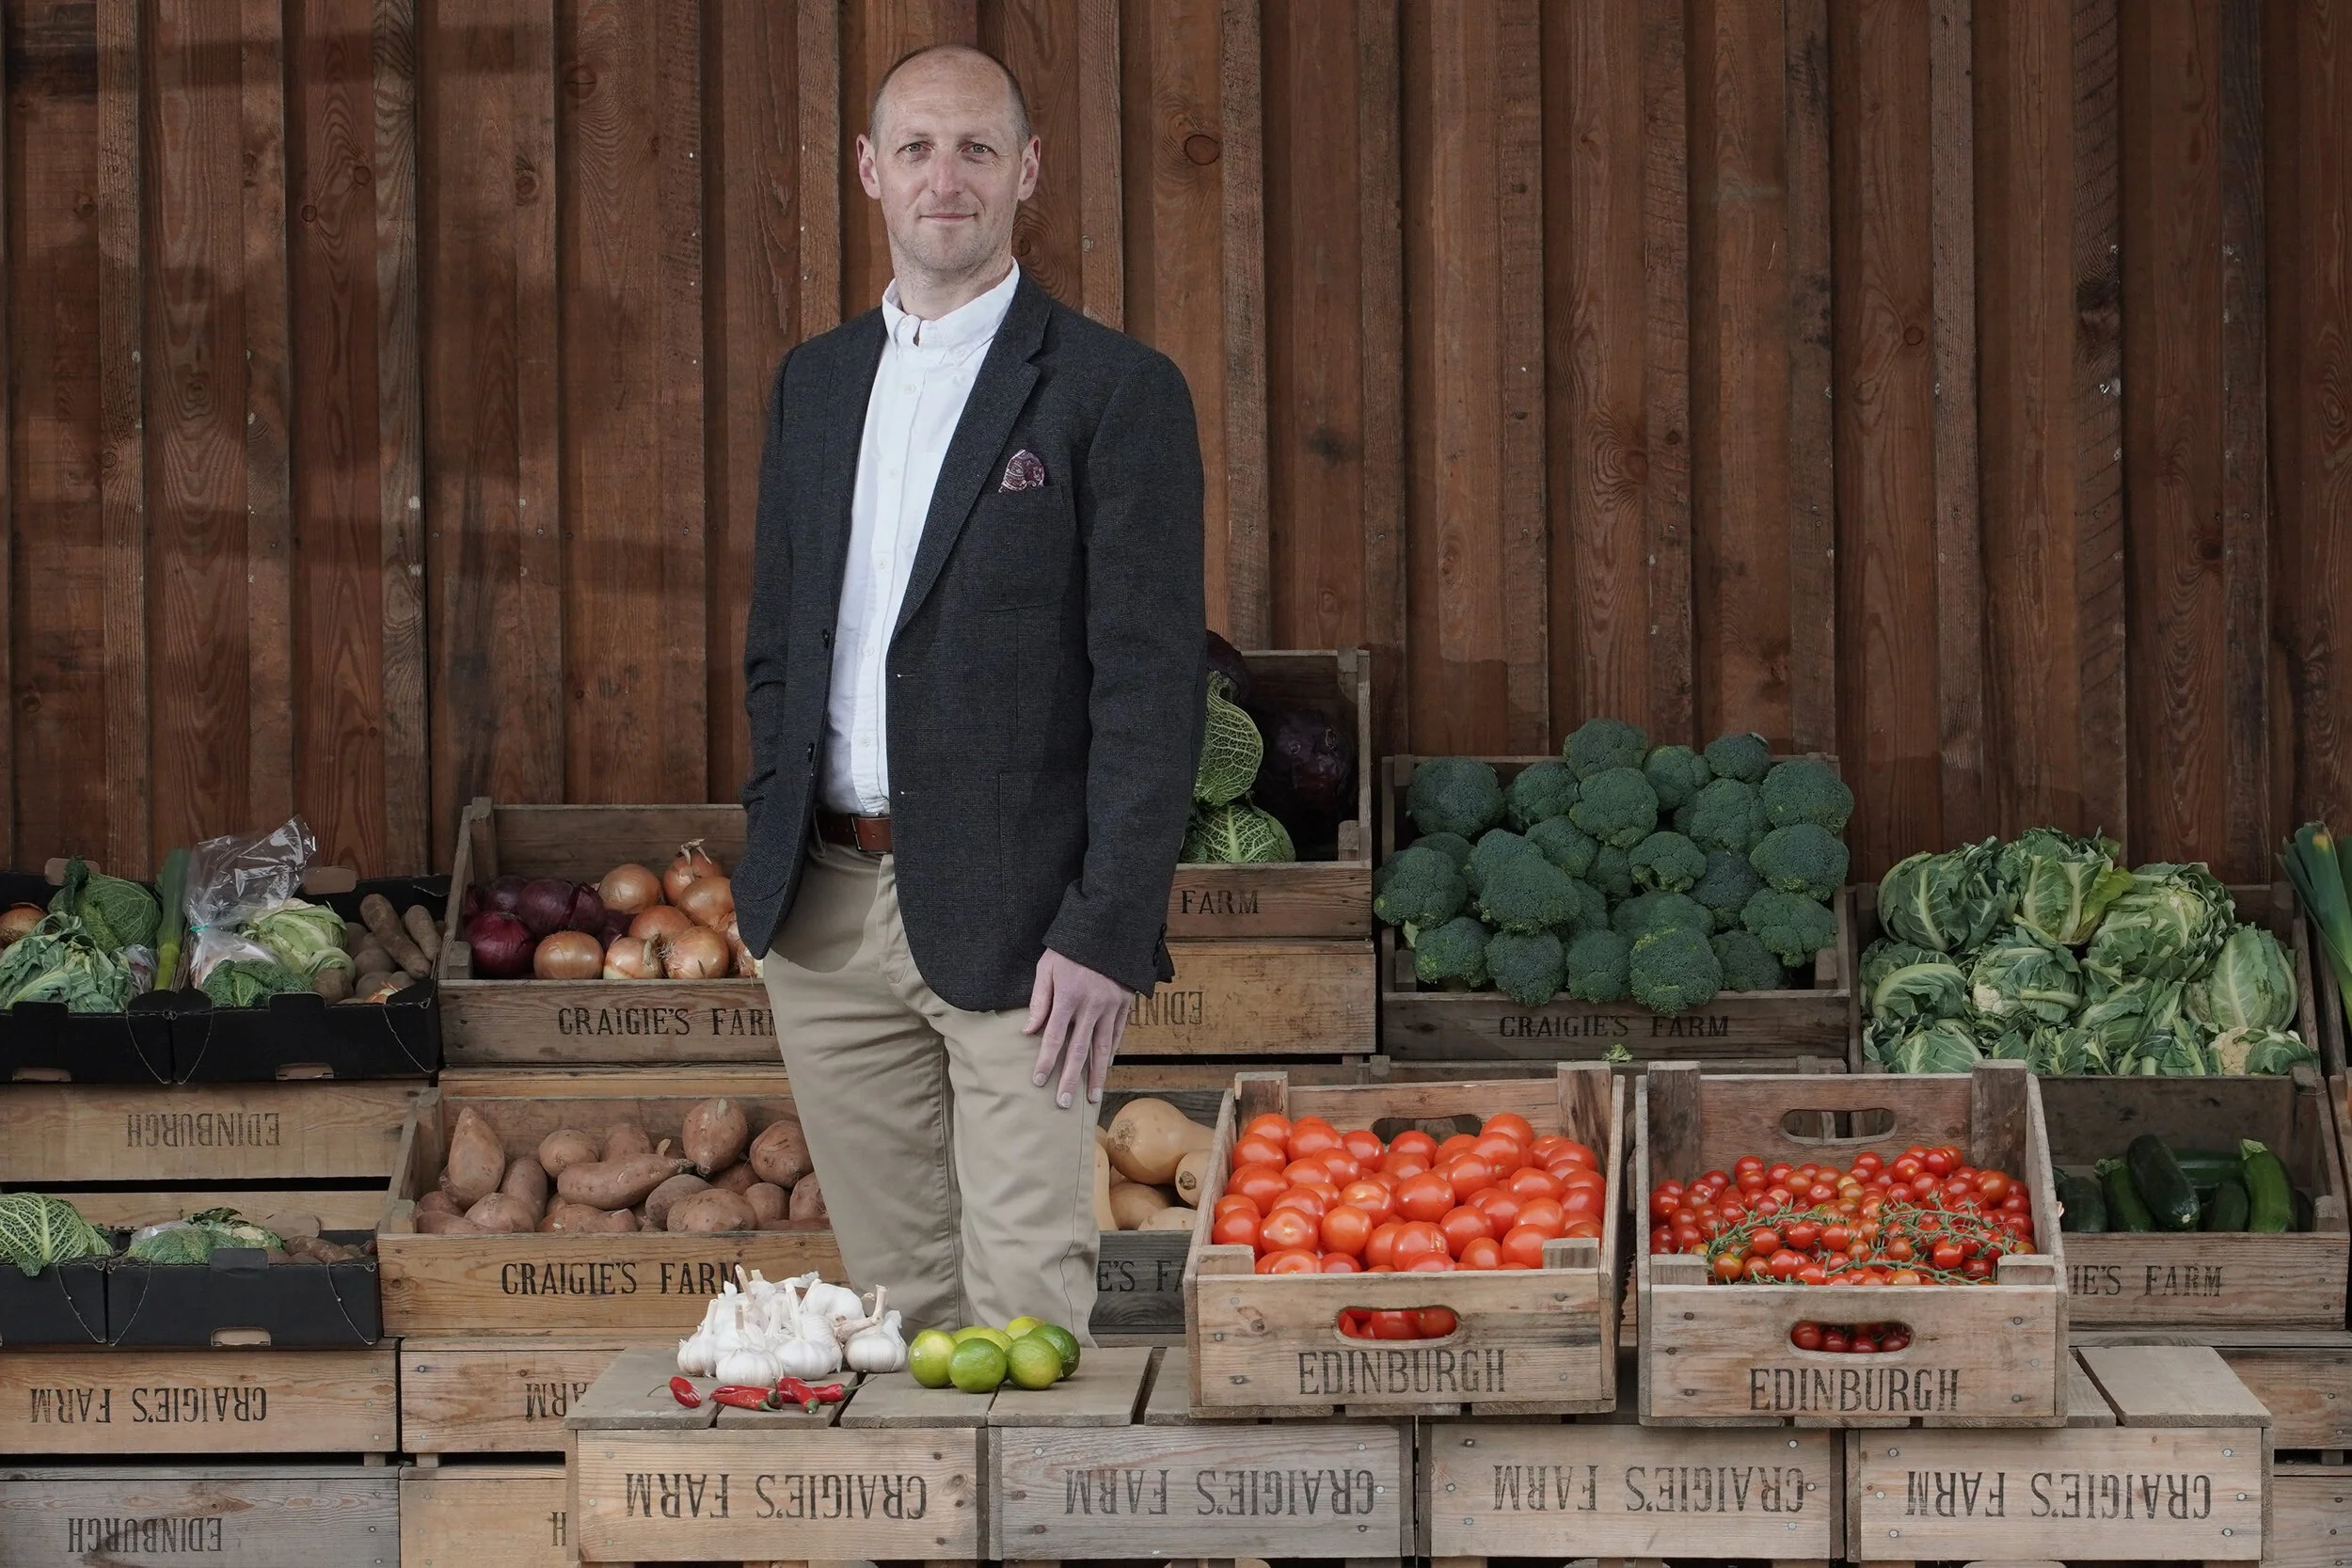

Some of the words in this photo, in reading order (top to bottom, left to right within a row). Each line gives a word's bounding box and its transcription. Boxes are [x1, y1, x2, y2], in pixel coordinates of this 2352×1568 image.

[1181, 890, 1259, 914] FARM
[559, 1007, 691, 1036] CRAIGIE'S
[1500, 1015, 1629, 1037] CRAIGIE'S
[1651, 1015, 1729, 1037] FARM
[127, 1113, 280, 1148] EDINBURGH
[501, 1262, 637, 1294] CRAIGIE'S
[660, 1262, 742, 1294] FARM
[2143, 1264, 2223, 1297] FARM
[1297, 1349, 1505, 1395] EDINBURGH
[1750, 1368, 1960, 1412] EDINBURGH
[30, 1387, 111, 1423] FARM
[132, 1386, 267, 1423] CRAIGIE'S
[625, 1473, 730, 1519] FARM
[755, 1474, 928, 1520] CRAIGIE'S
[1063, 1469, 1170, 1515] FARM
[1196, 1469, 1375, 1516] CRAIGIE'S
[1493, 1465, 1598, 1512] FARM
[1625, 1465, 1804, 1513] CRAIGIE'S
[1905, 1471, 2006, 1518] FARM
[2030, 1472, 2211, 1520] CRAIGIE'S
[68, 1517, 223, 1553] EDINBURGH
